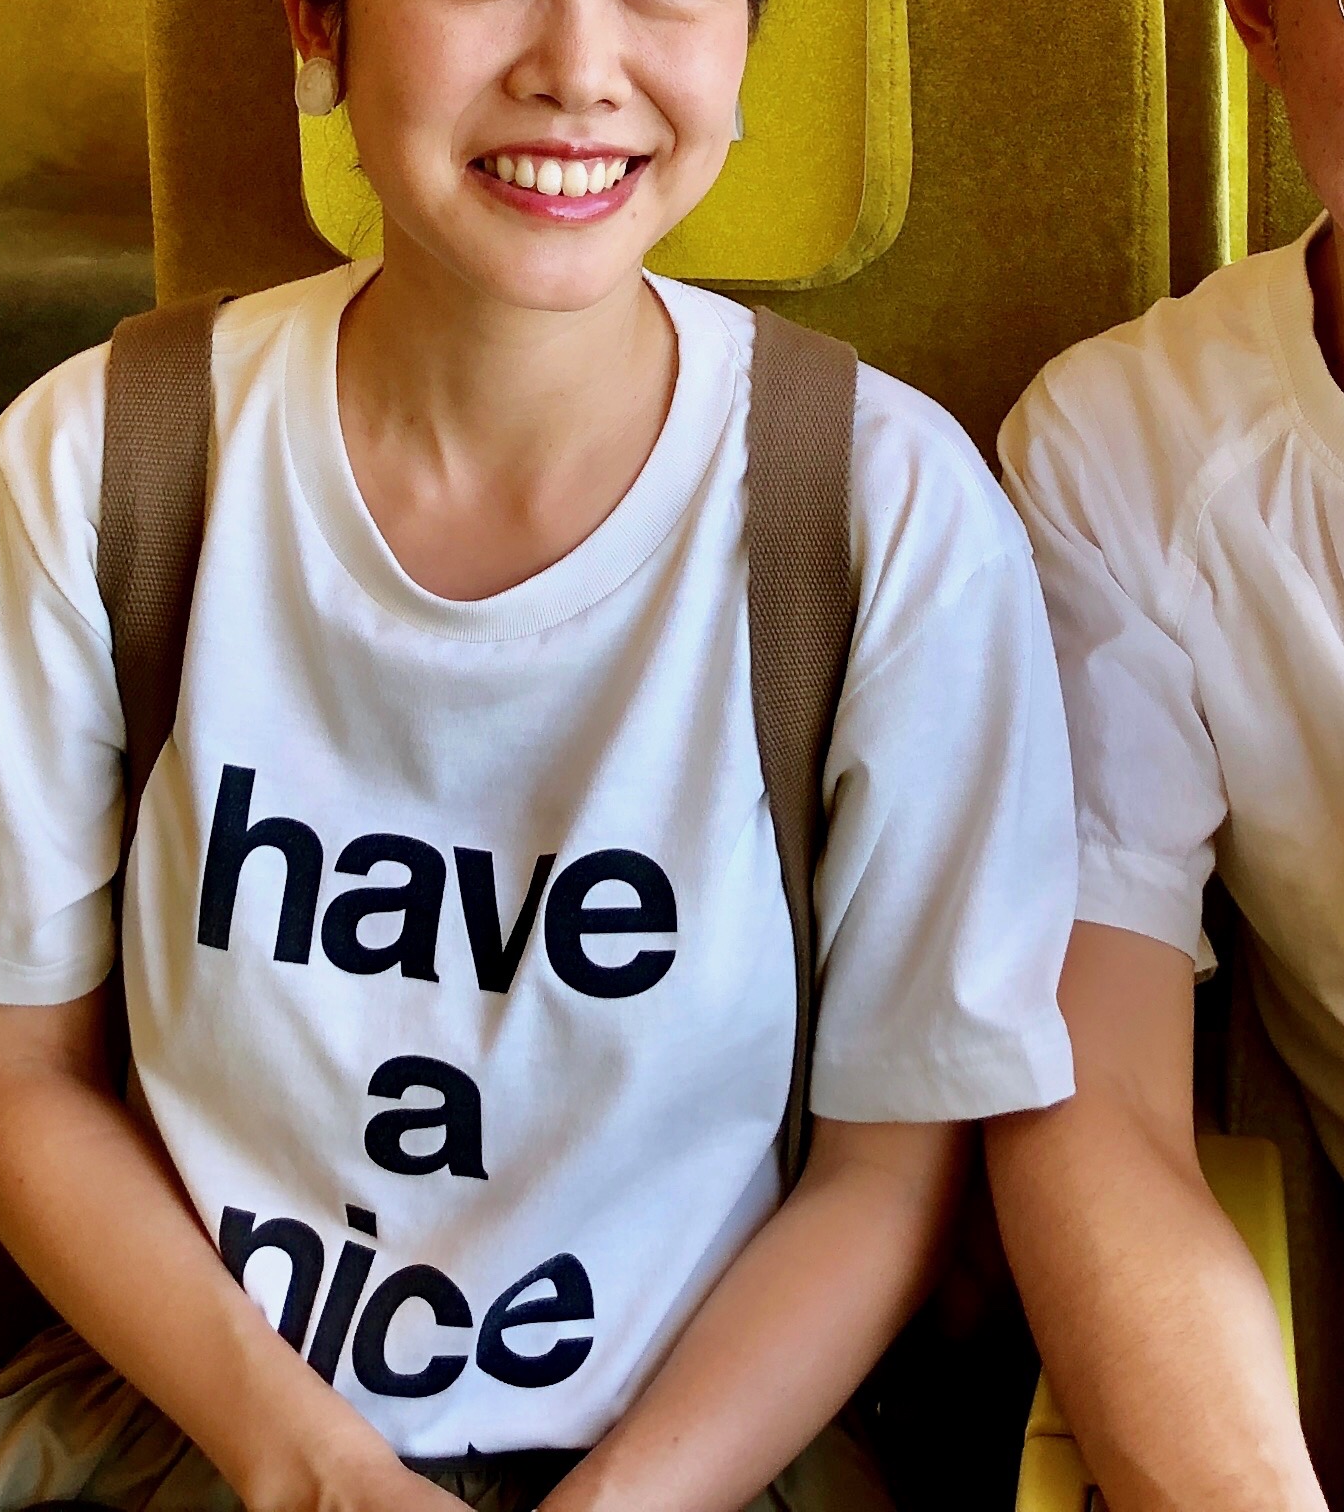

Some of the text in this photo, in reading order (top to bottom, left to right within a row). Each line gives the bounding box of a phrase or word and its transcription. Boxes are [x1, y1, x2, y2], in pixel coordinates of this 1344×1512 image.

[197, 763, 678, 999] have
[364, 1054, 488, 1180] a
[219, 1203, 595, 1399] nice
